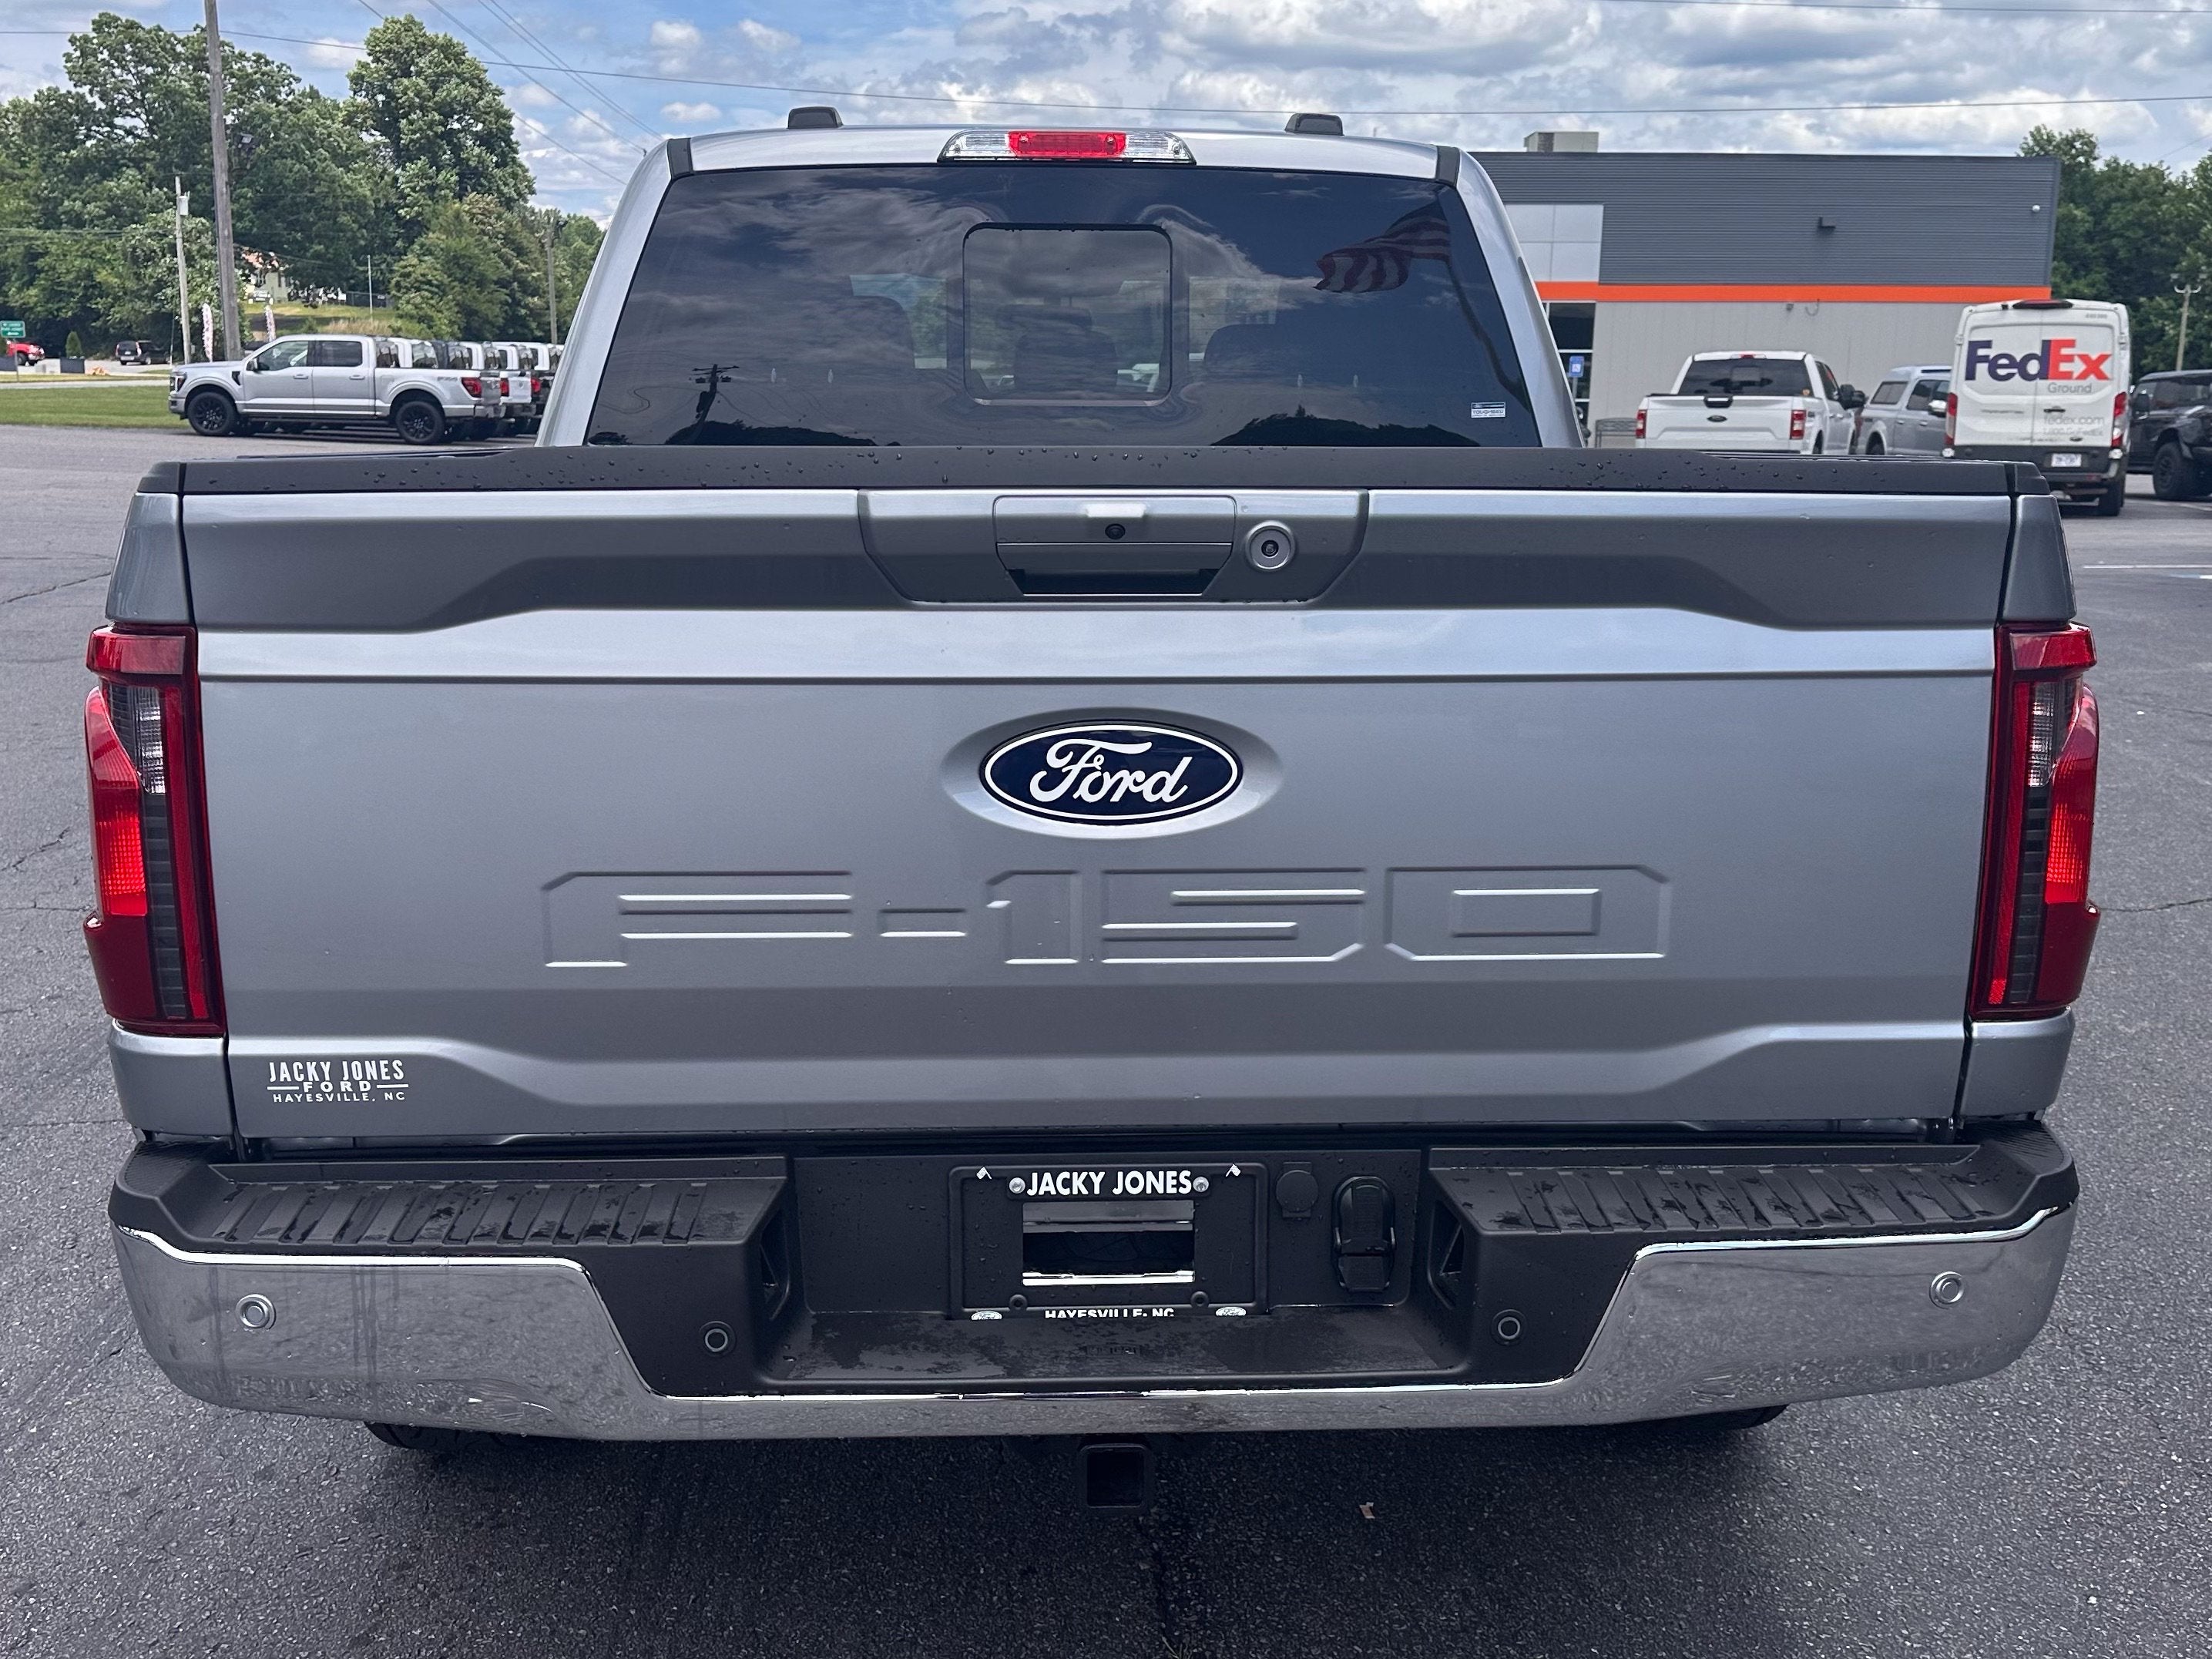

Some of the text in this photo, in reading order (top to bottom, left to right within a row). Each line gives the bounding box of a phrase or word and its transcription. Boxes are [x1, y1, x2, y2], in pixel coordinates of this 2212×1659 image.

[1965, 339, 2113, 381] FedEx
[2047, 382, 2093, 394] Ground
[1029, 738, 1193, 803] Ford
[541, 865, 1670, 968] F-150
[270, 1060, 404, 1082] JACKY JONES
[303, 1080, 371, 1092] FORD
[384, 1091, 405, 1100] NC
[1026, 1170, 1192, 1196] JACKY JONES
[1152, 1308, 1174, 1317] NC
